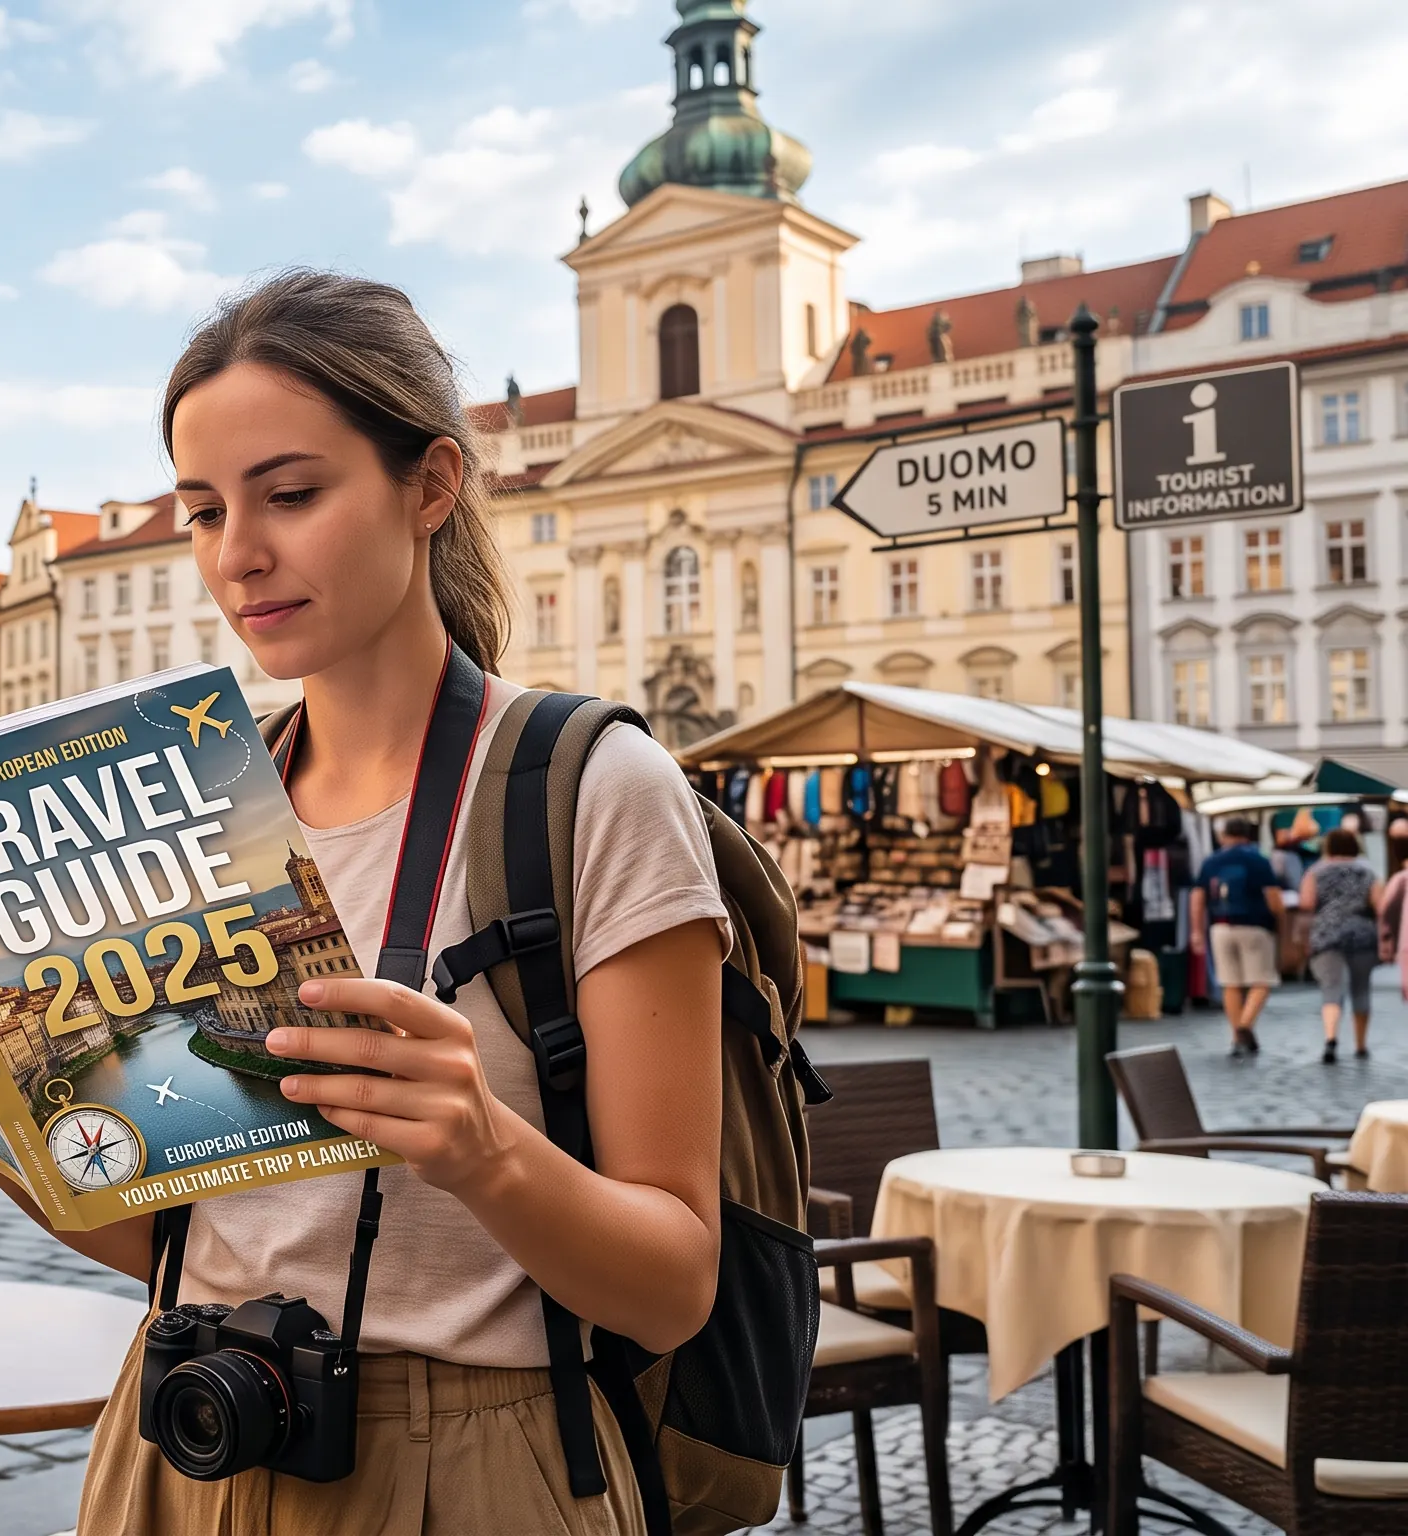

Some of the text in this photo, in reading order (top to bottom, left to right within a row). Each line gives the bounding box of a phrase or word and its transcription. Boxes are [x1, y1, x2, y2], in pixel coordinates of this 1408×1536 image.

[896, 439, 1037, 488] DUOMO
[1156, 464, 1255, 493] TOURIST
[927, 485, 1007, 516] 5 MIN
[1127, 482, 1287, 520] INFORMATION
[58, 725, 129, 762] EDITION
[23, 903, 279, 1039] 2025
[164, 1119, 311, 1165] EUROPEAN EDITION
[118, 1181, 168, 1208] YOUR
[167, 1161, 253, 1196] ULTIMATE
[253, 1153, 294, 1177] TRIP
